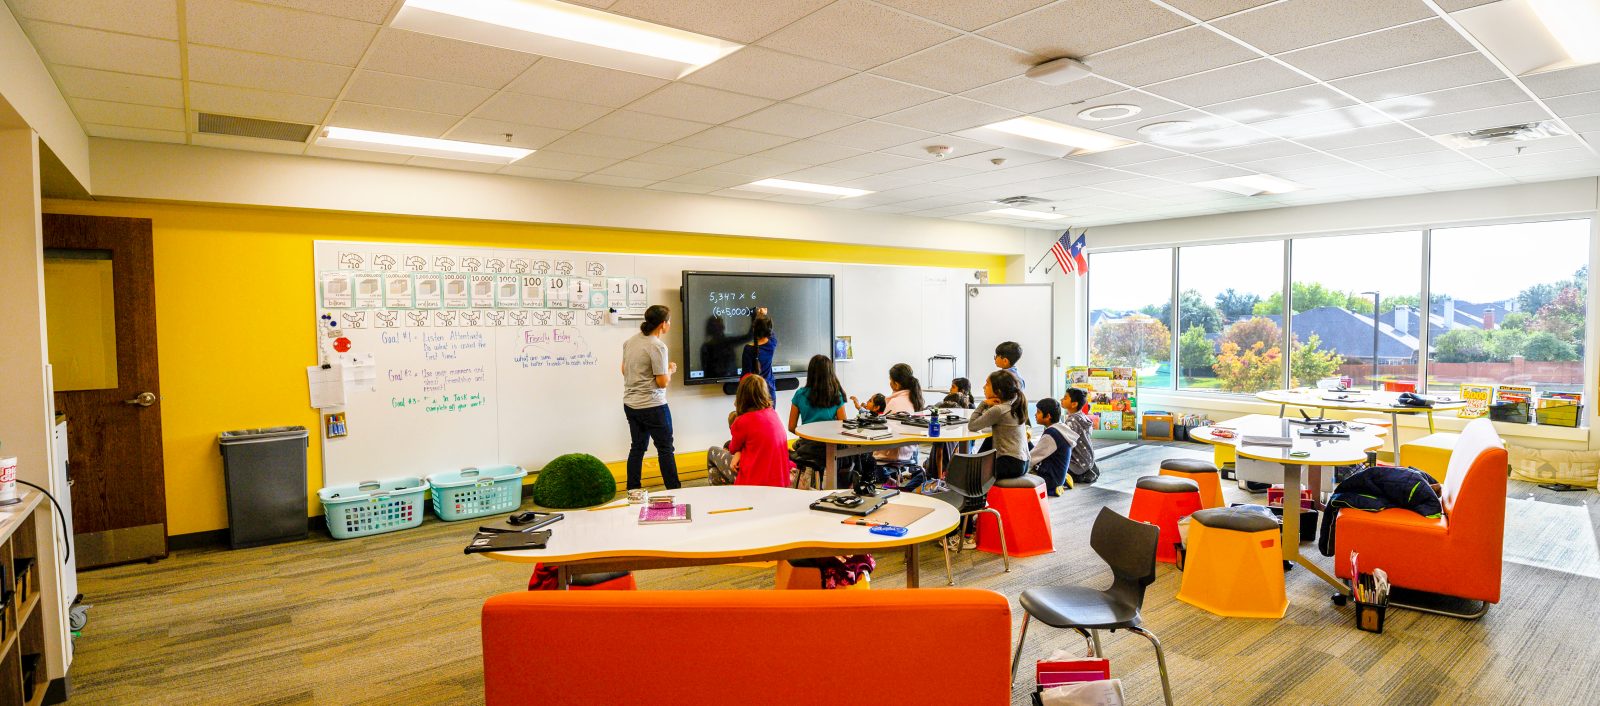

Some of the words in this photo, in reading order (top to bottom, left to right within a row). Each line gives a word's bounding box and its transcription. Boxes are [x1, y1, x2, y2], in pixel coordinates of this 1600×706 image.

[524, 278, 541, 286] 100
[551, 278, 563, 288] 10
[577, 281, 583, 293] 1
[613, 284, 621, 294] .1
[710, 292, 735, 303] 5,347
[751, 291, 756, 299] 6
[382, 331, 399, 344] Goal
[423, 332, 444, 342] Listen
[388, 370, 403, 381] Goal
[1464, 392, 1487, 400] 5,000
